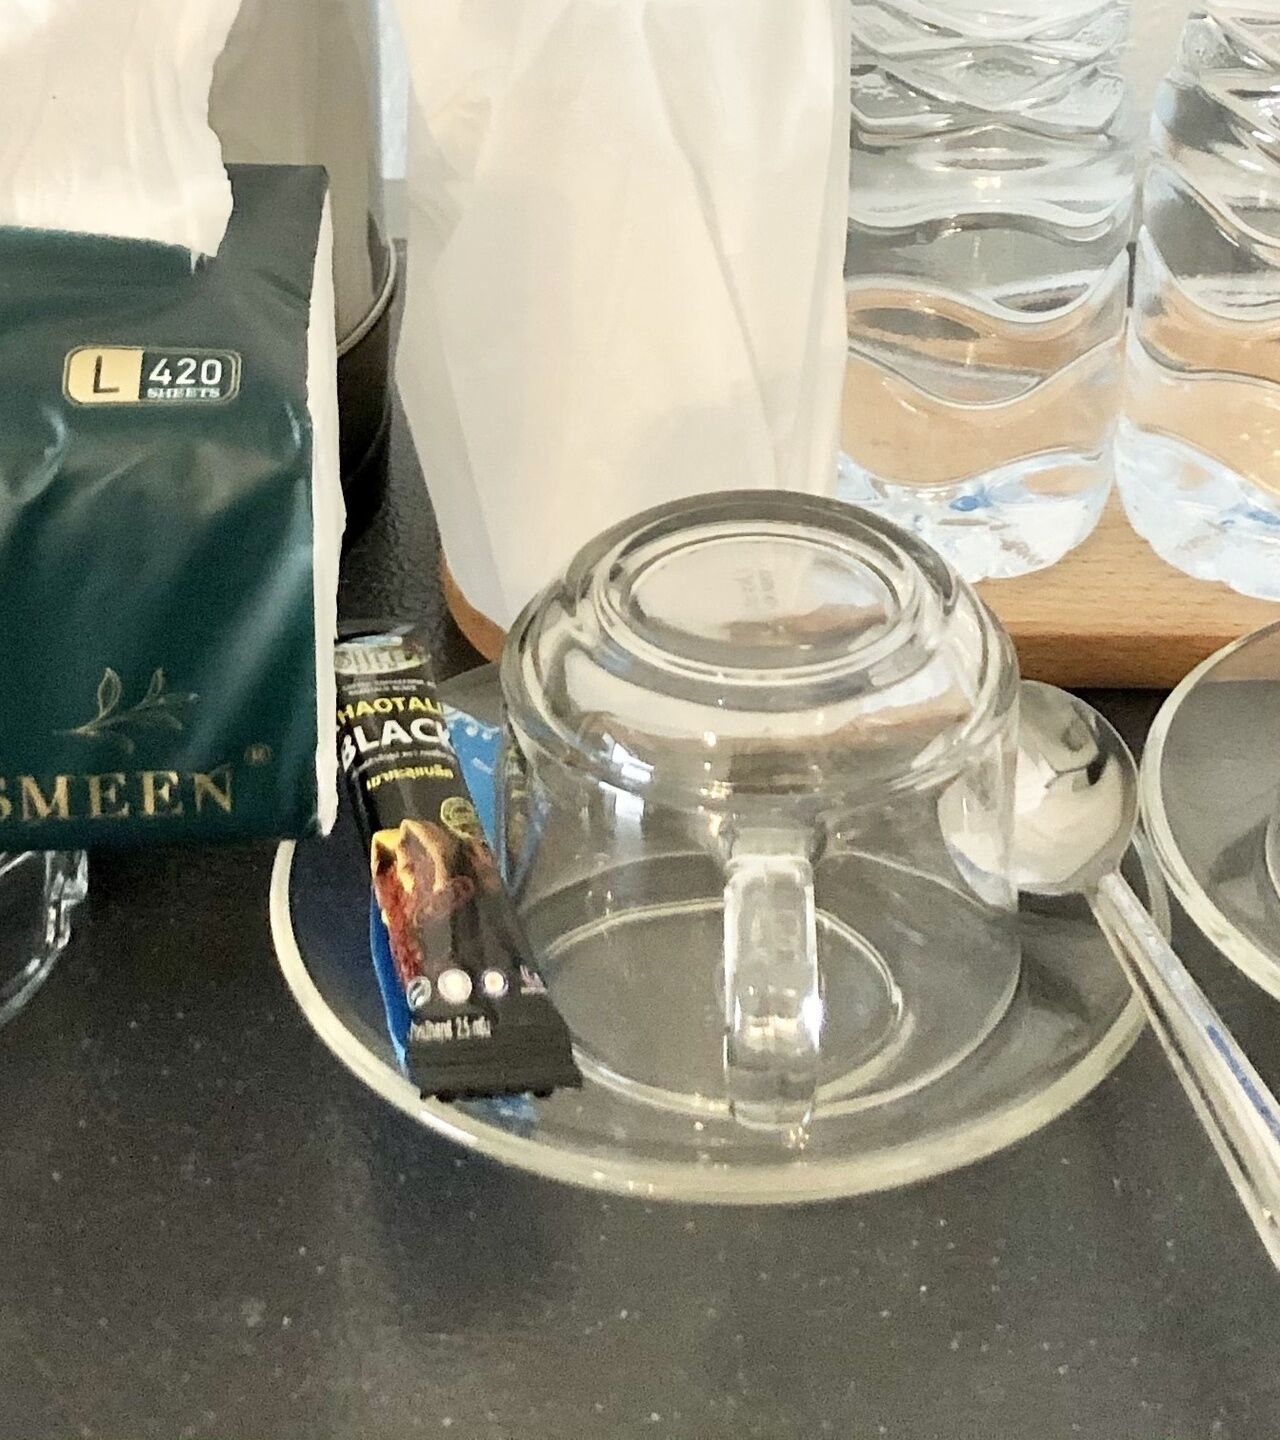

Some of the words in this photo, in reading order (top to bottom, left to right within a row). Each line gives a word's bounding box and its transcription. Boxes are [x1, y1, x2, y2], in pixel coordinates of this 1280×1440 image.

[92, 354, 120, 394] L
[148, 357, 223, 386] 420
[147, 387, 221, 399] SHEETS
